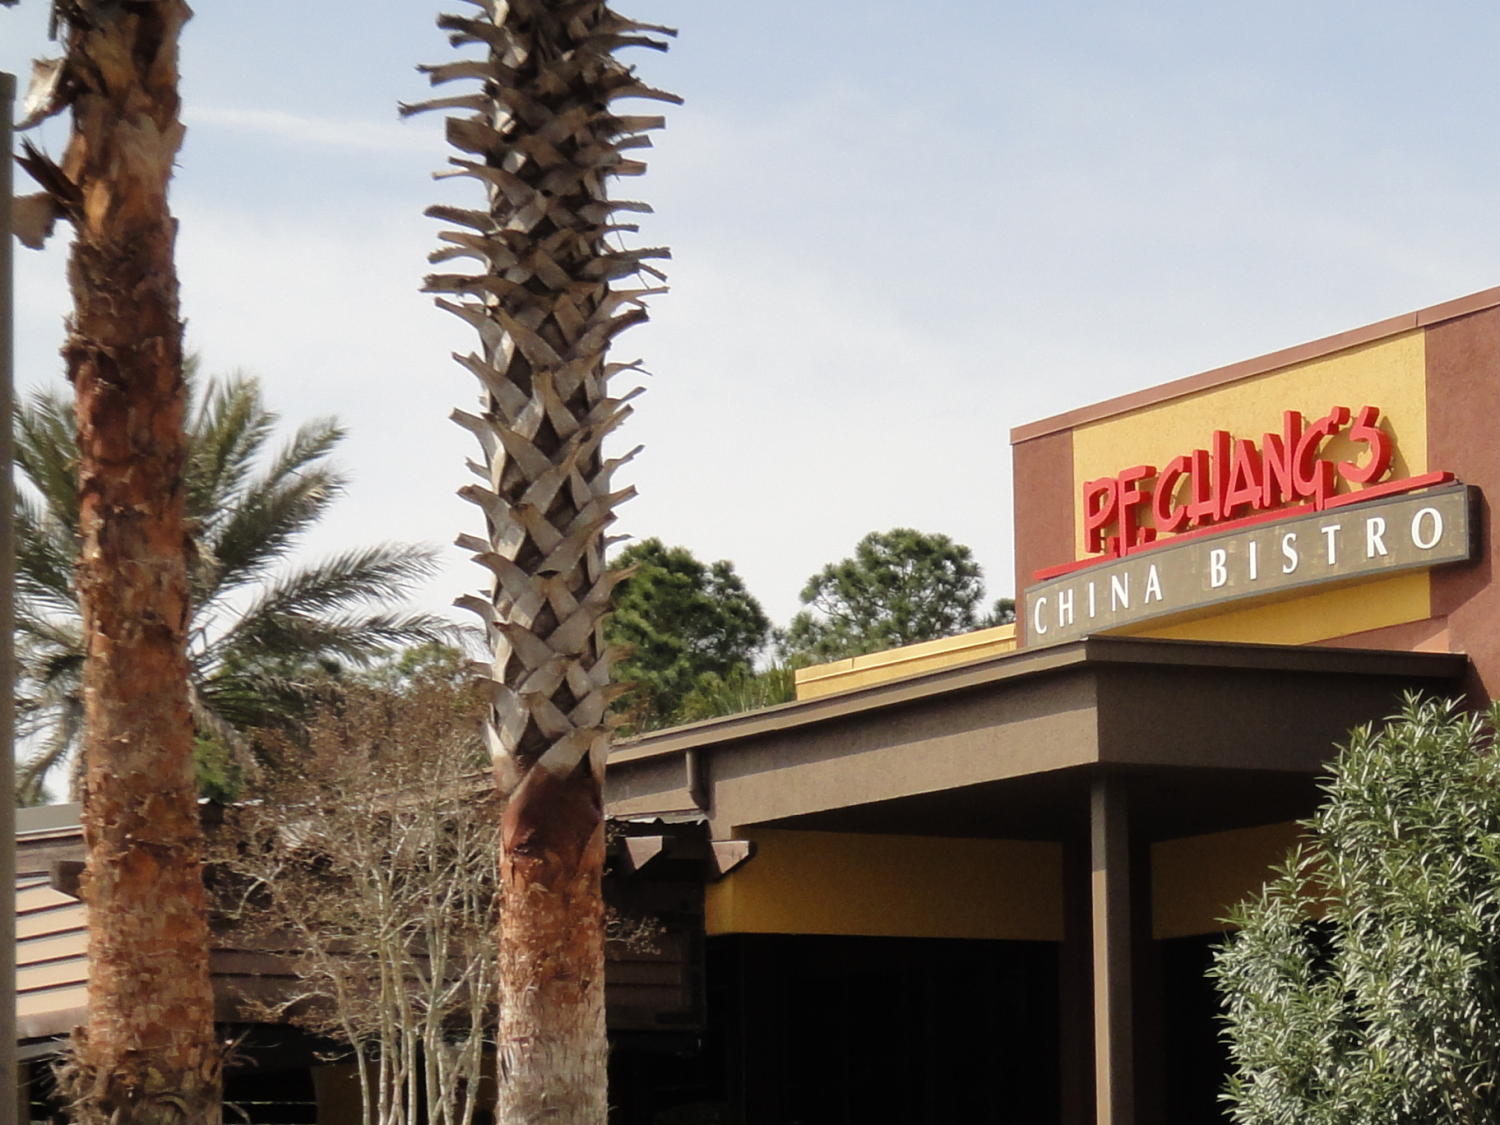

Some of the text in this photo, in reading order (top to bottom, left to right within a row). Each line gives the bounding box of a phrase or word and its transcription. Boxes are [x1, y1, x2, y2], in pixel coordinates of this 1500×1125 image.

[1153, 406, 1392, 532] CHANG'S
[1033, 506, 1444, 635] CHINA BISTRO
